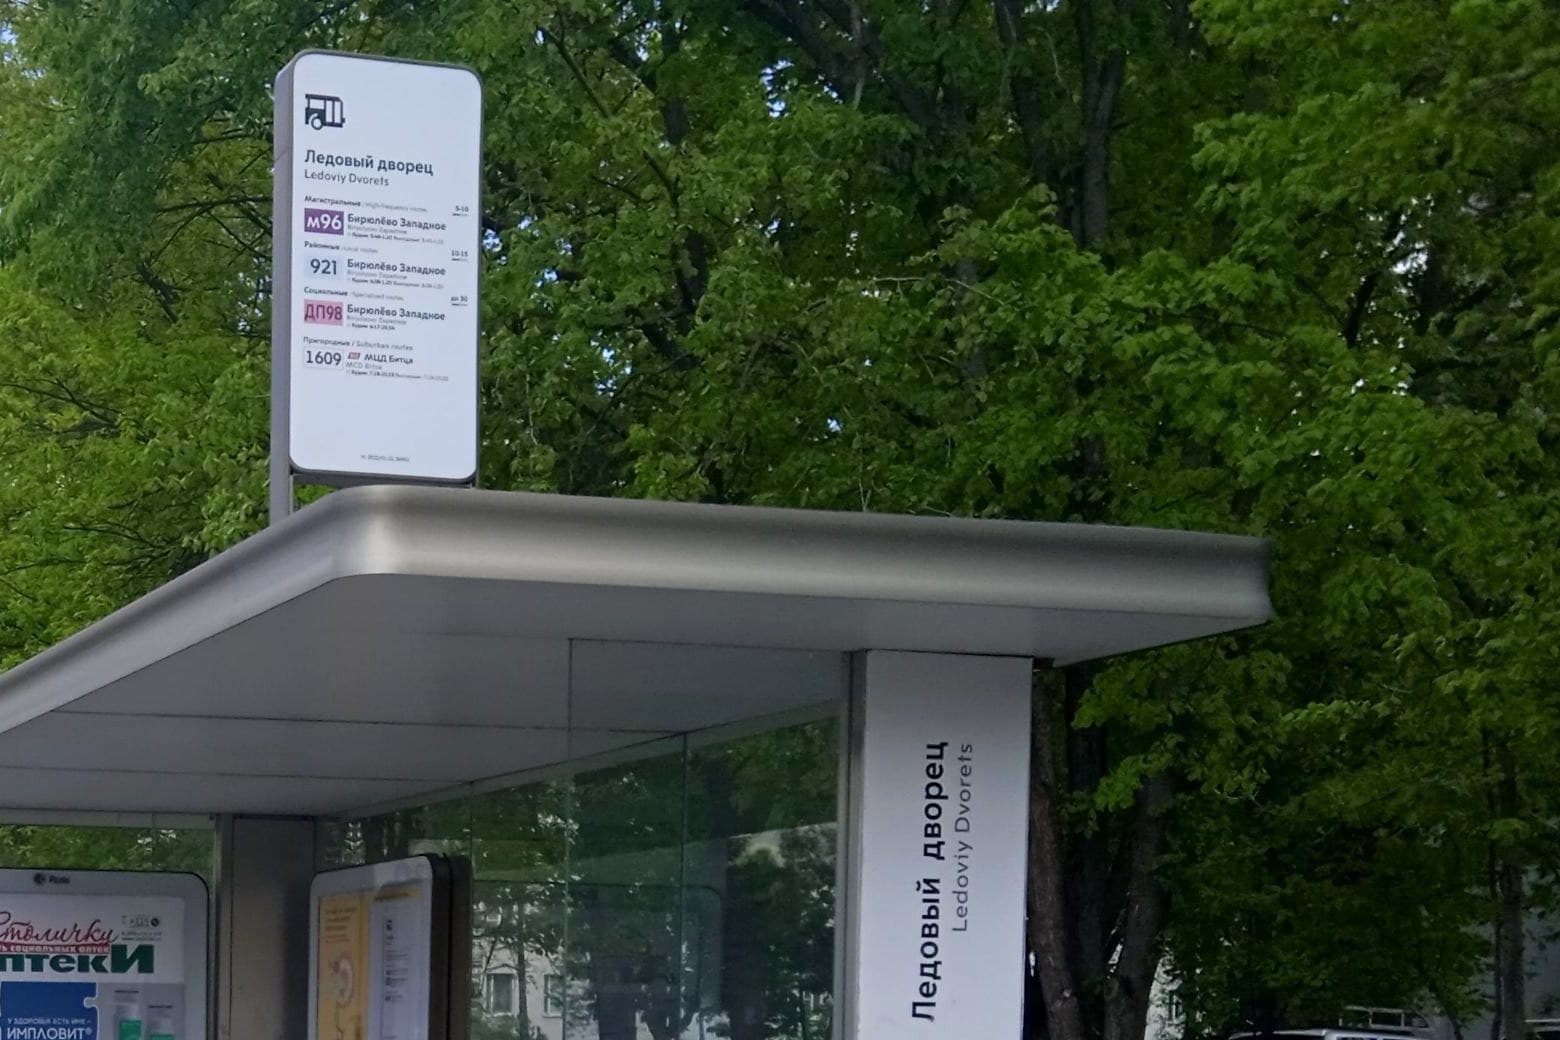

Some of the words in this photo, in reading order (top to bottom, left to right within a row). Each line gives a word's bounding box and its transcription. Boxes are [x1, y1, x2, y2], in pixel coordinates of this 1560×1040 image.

[304, 150, 374, 169] Ледовый
[377, 159, 433, 176] дворец
[304, 169, 346, 184] Ledoviy
[349, 173, 389, 186] Dvorets
[347, 213, 398, 227] Бирюлёво
[400, 217, 446, 231] Западное
[310, 258, 338, 275] 921
[347, 258, 397, 272] Бирюлёво
[399, 263, 446, 276] Западное
[304, 304, 343, 323] ДП98
[347, 303, 397, 317] Бирюлёво
[399, 308, 446, 321] Западное
[306, 350, 342, 366] 1609
[364, 353, 387, 363] МЦД
[389, 354, 413, 365] Битца
[954, 743, 973, 833] Dvorets
[923, 741, 949, 860] дворец
[952, 840, 974, 932] Ledoviy
[10, 945, 77, 954] социальных
[78, 945, 110, 954] аптек
[911, 877, 941, 1022] Ледовый
